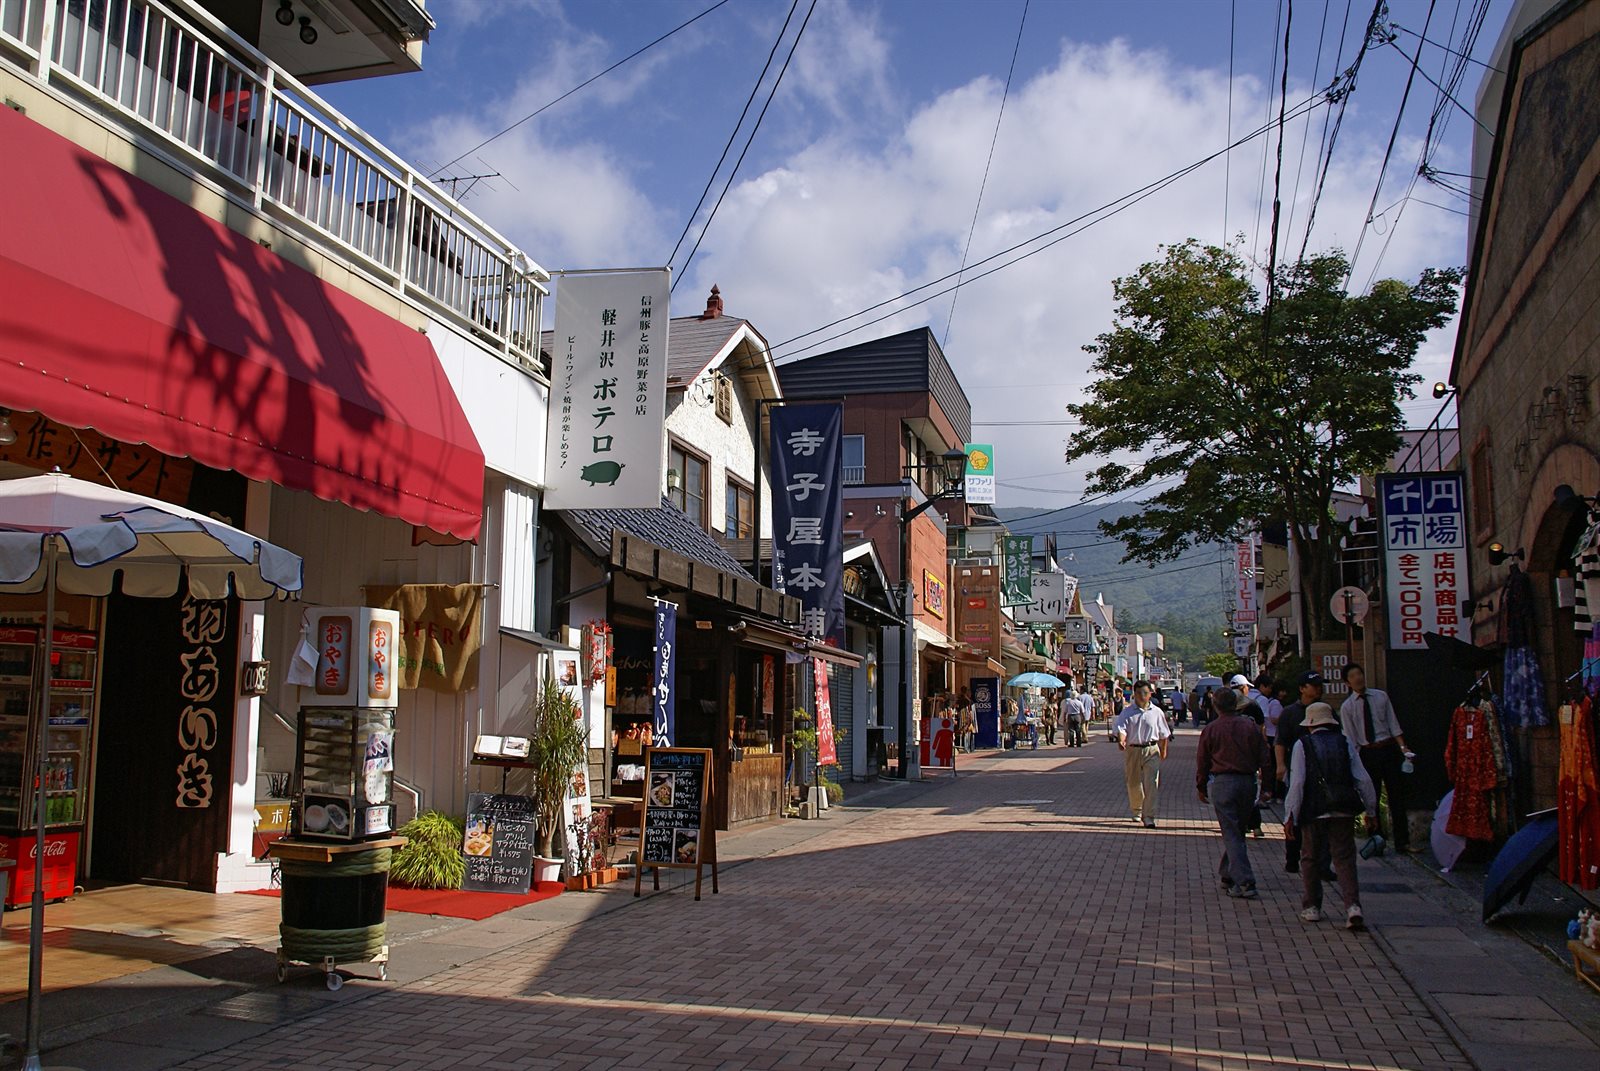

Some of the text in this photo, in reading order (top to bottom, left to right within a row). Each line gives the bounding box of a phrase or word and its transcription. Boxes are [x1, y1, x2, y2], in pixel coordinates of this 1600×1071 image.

[592, 308, 618, 454] 軽井沢 ボテロ
[635, 295, 652, 416] 信州豚と高原野菜の店
[5, 415, 183, 496] 作りサンド
[785, 427, 827, 637] 寺子屋本舗
[1389, 480, 1457, 512] 千円
[1389, 515, 1458, 546] 市場
[324, 623, 342, 688] おやき
[373, 627, 387, 692] おやき
